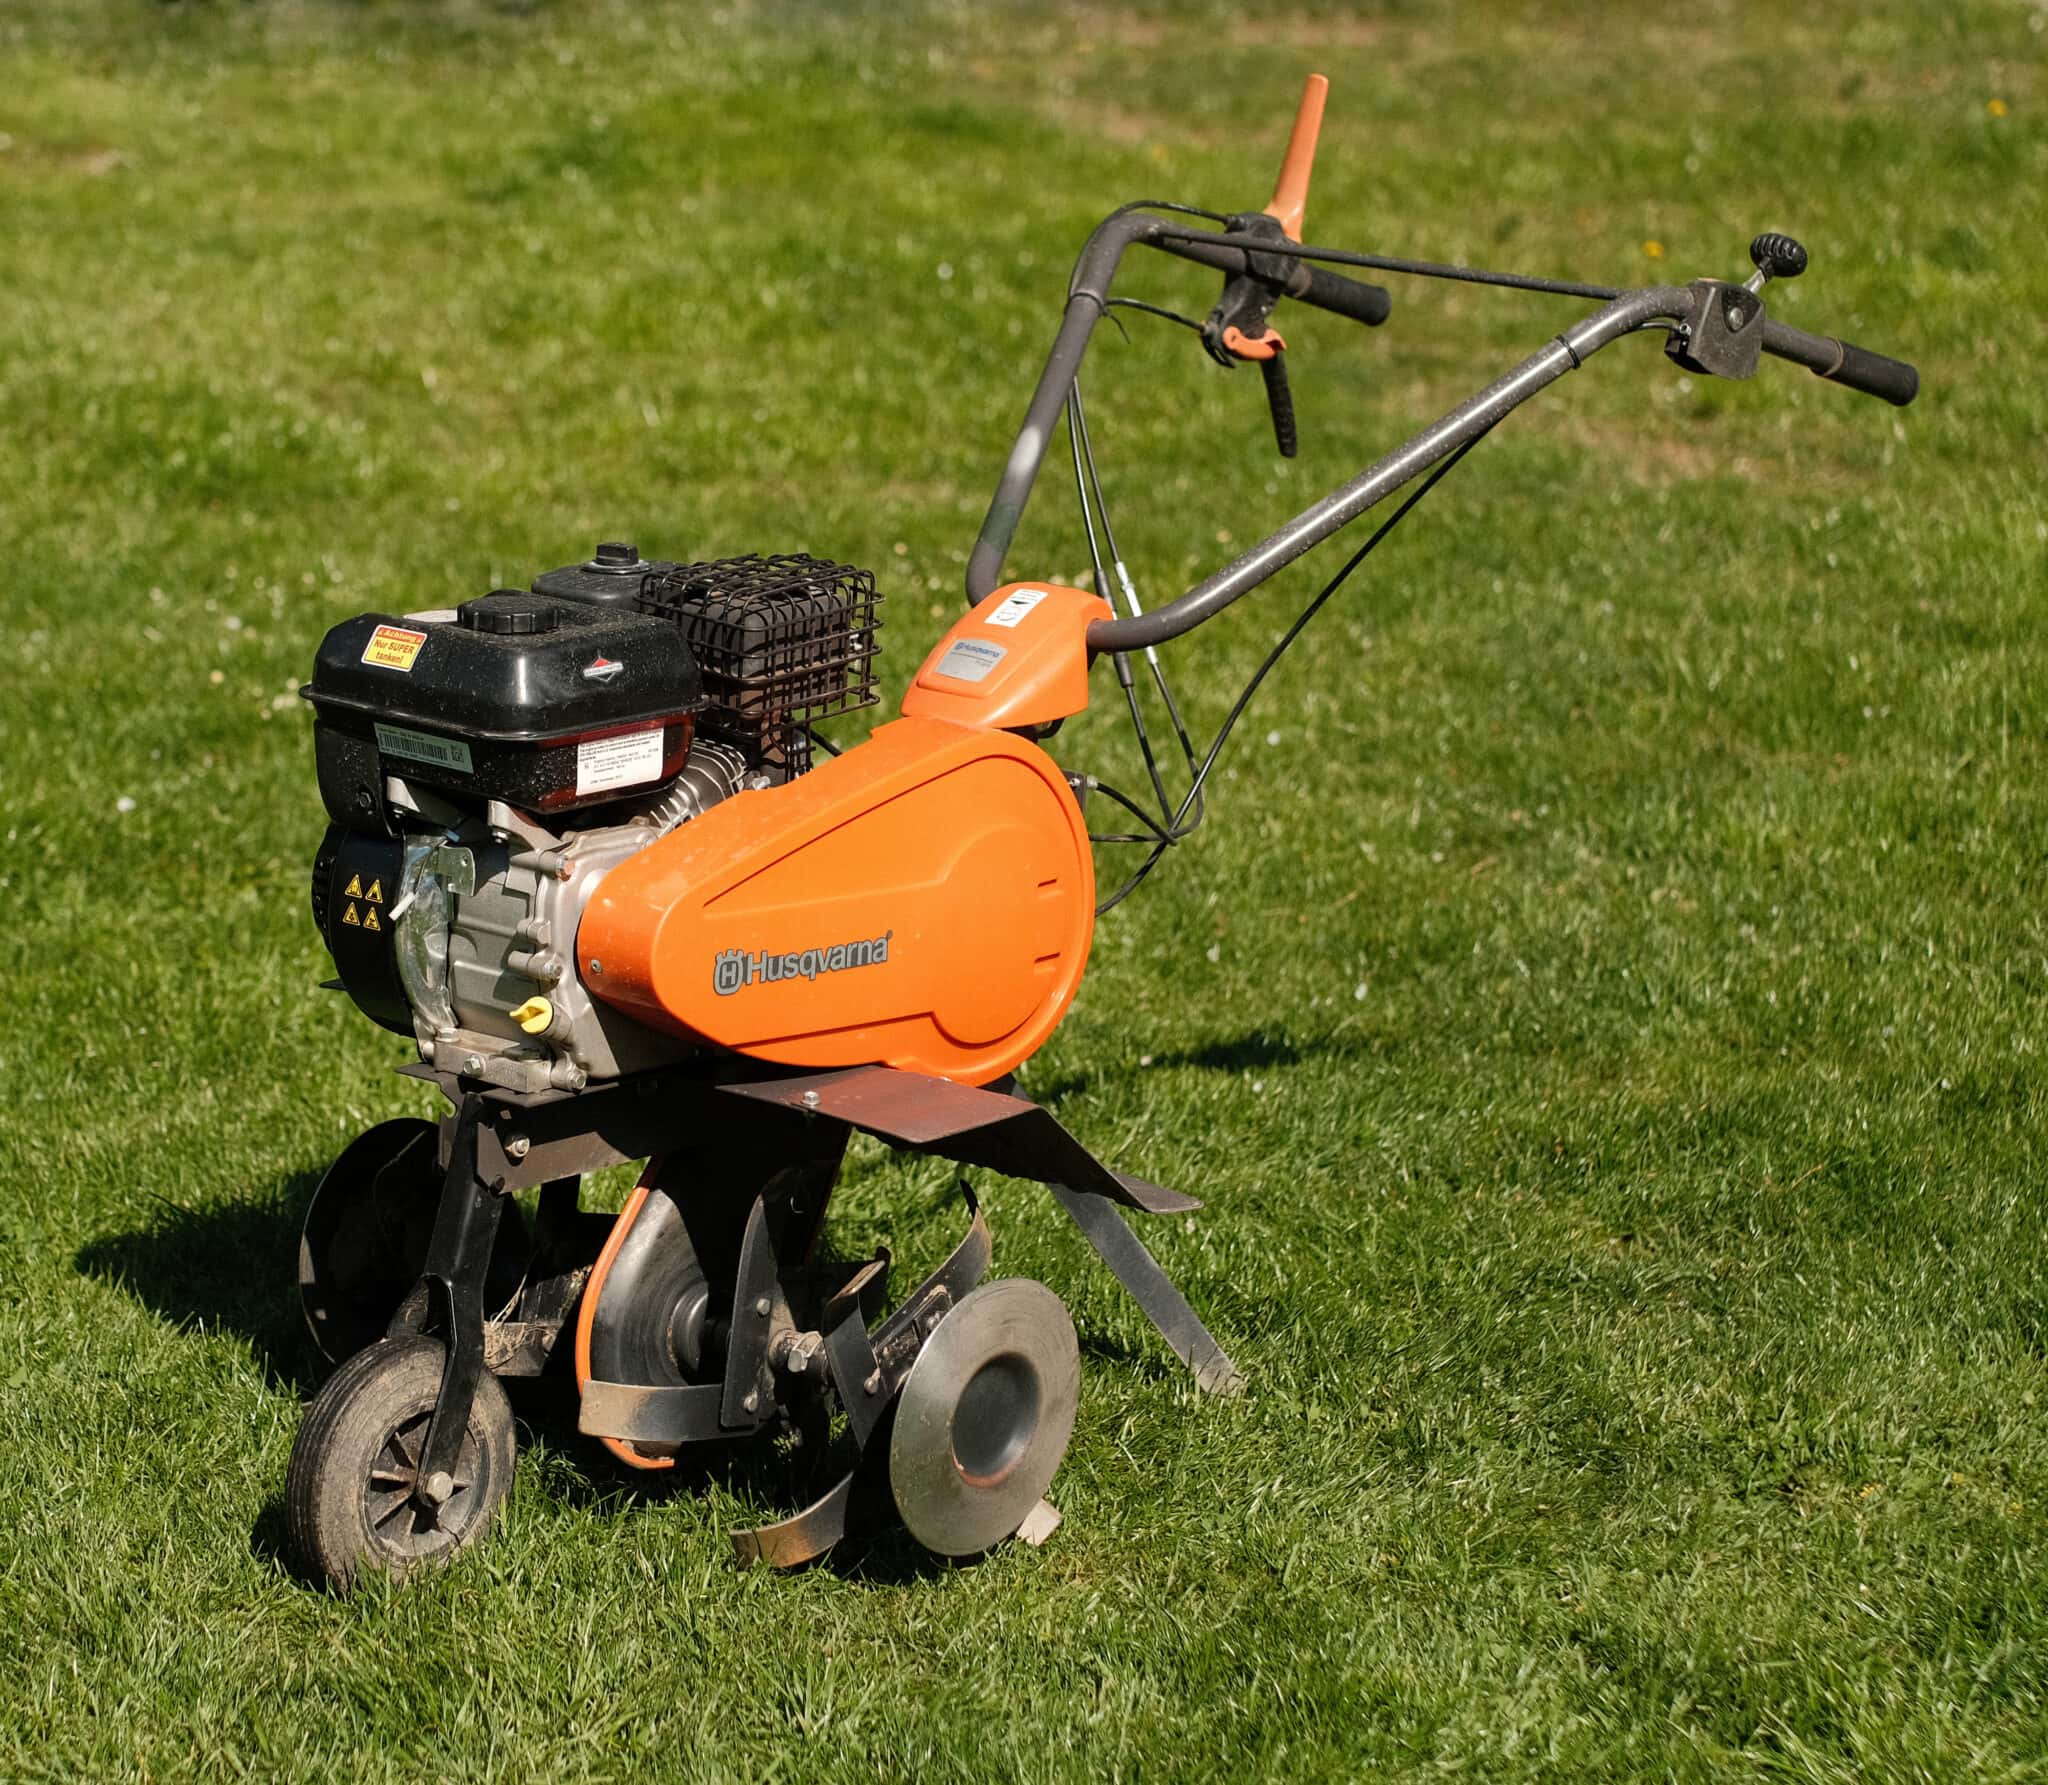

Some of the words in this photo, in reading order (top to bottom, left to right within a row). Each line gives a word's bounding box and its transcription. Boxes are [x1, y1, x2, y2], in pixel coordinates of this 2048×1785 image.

[375, 639, 388, 649] Nur
[388, 642, 415, 655] SUPER
[745, 936, 888, 985] Husqvarna
